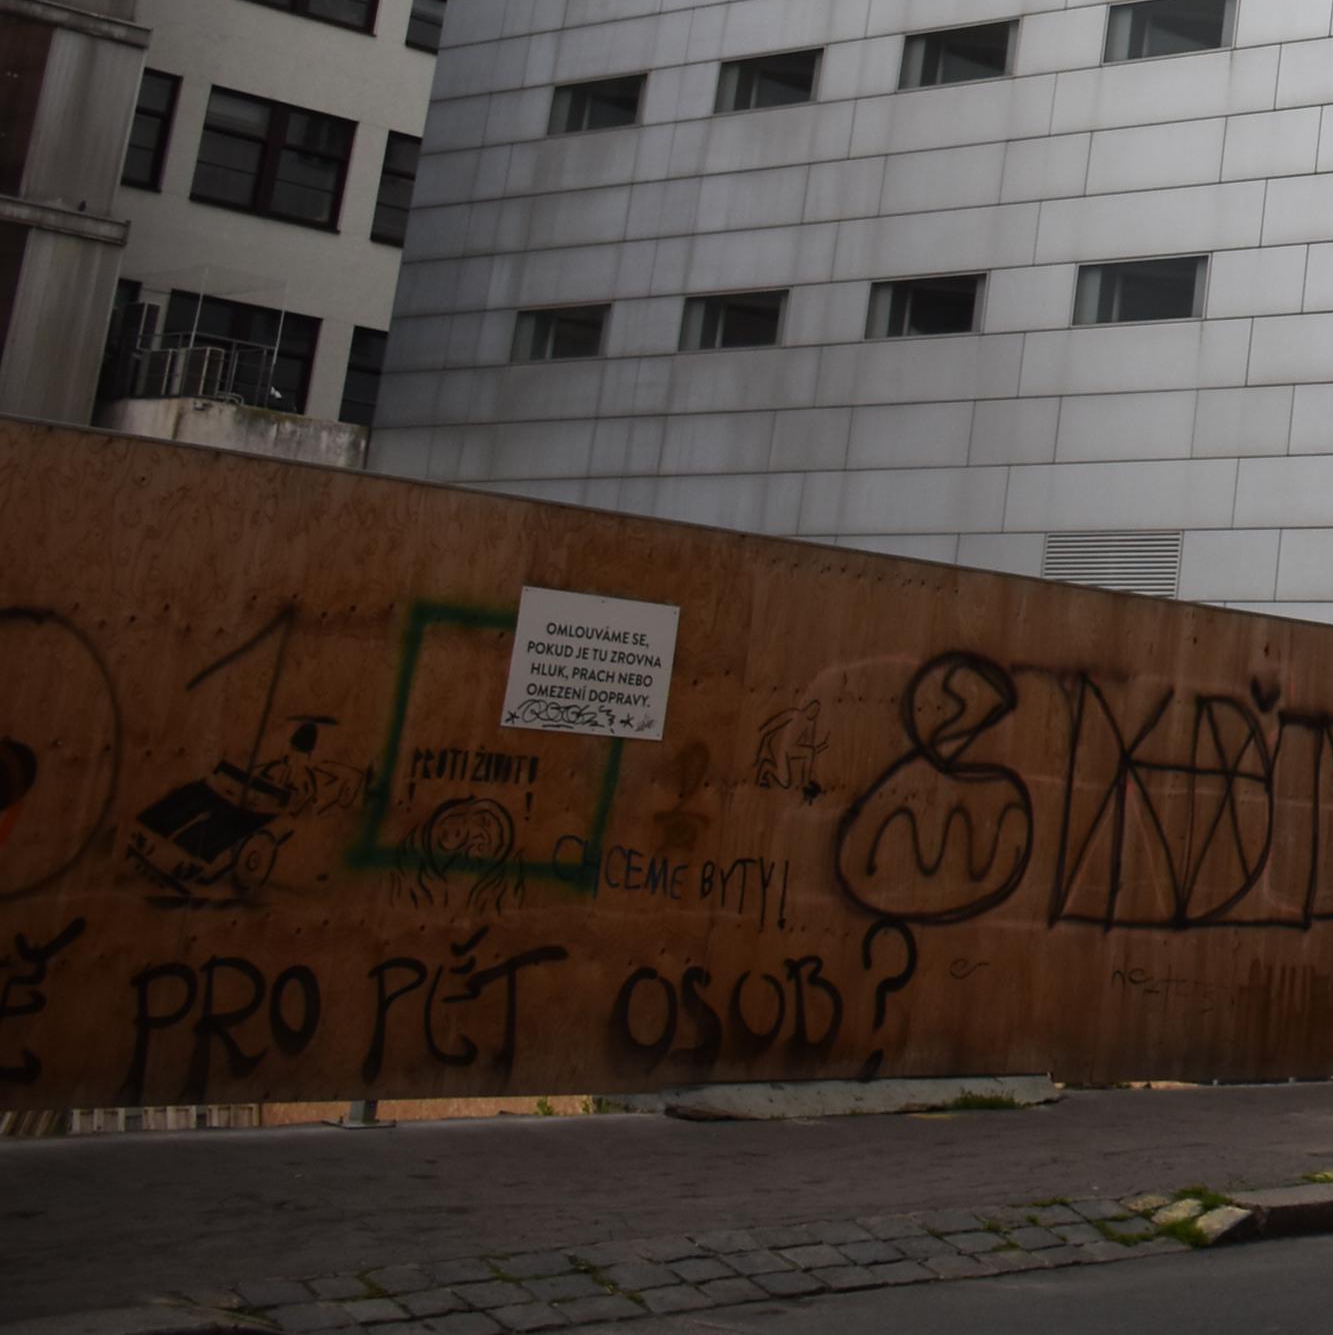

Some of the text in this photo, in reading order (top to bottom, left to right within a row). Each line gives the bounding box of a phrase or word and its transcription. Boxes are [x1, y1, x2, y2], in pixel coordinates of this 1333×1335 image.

[547, 623, 649, 648] OMLOUVÁME SE,
[527, 641, 662, 669] POKUD JE TU ZROVNA
[531, 663, 653, 687] HLUK, PRACH NEBO
[526, 683, 651, 708] OMEZENÍ DOPRAVY.
[552, 834, 688, 900] CHCEME
[120, 956, 321, 1104] PRO
